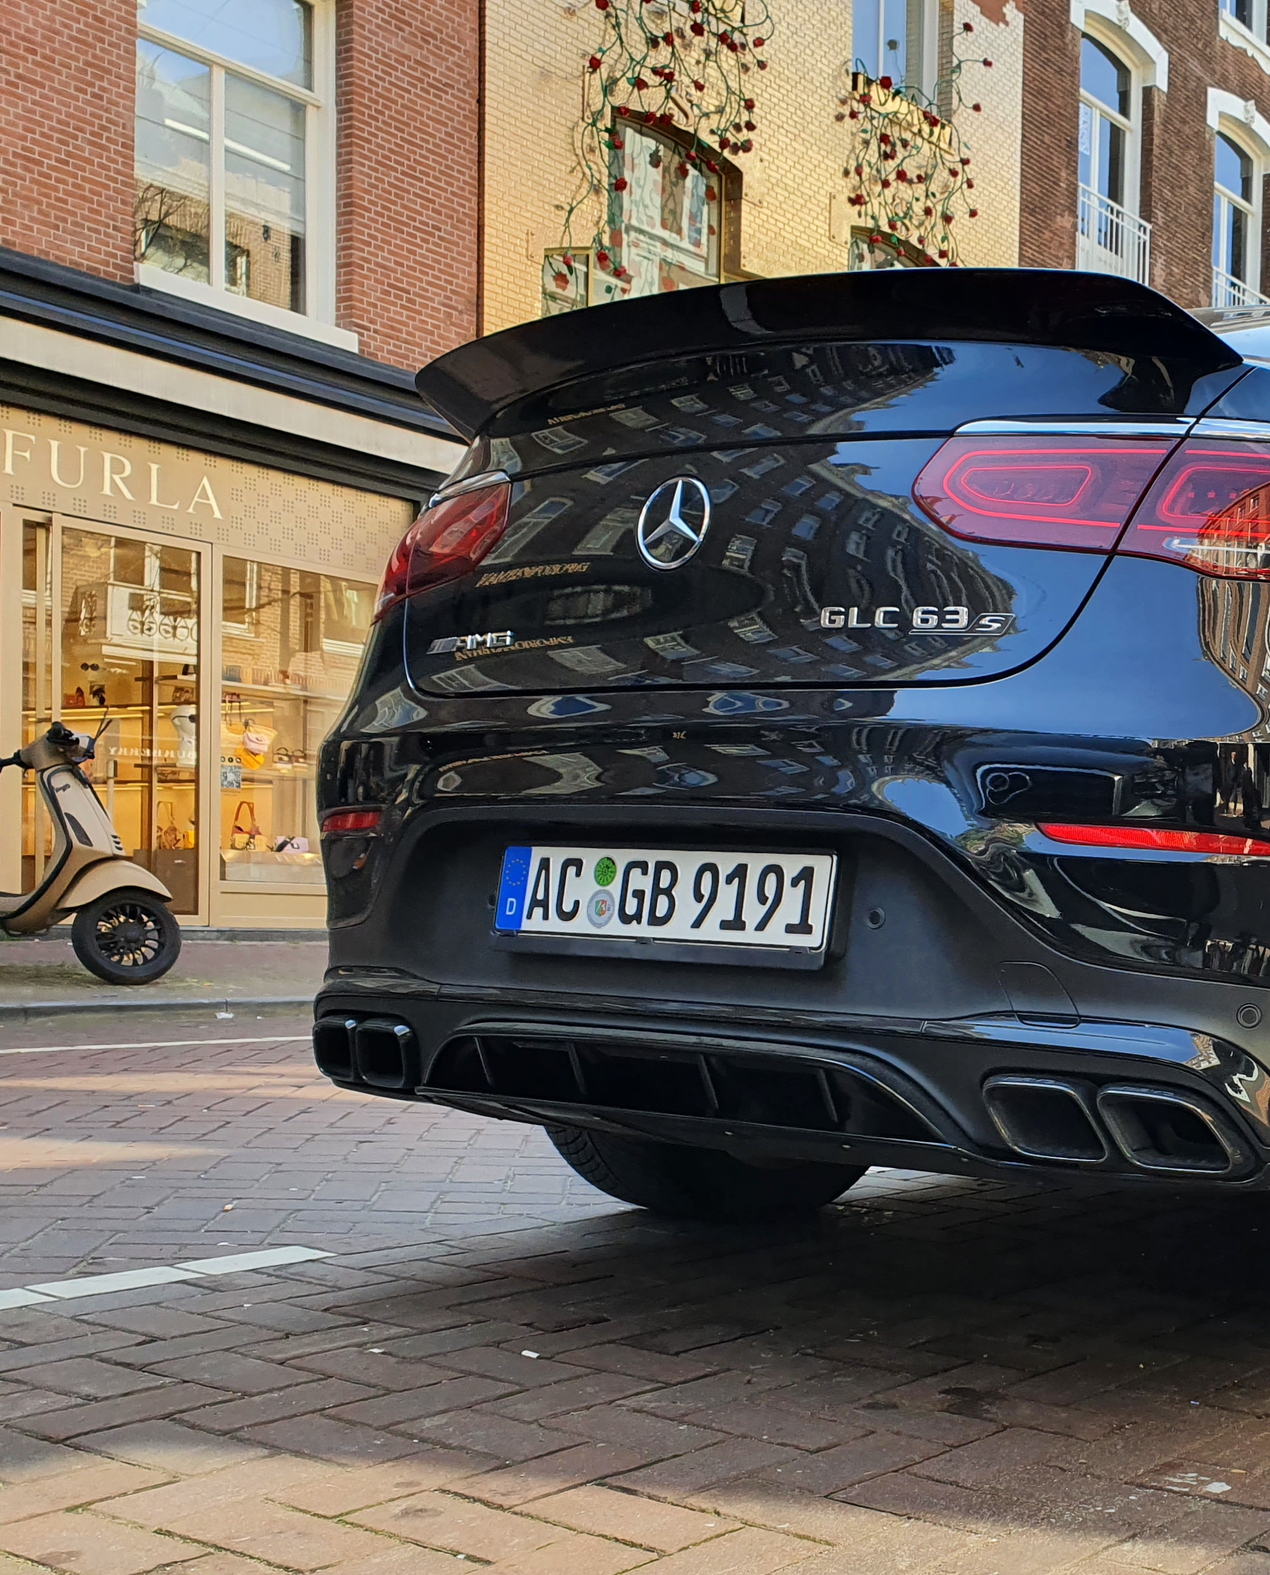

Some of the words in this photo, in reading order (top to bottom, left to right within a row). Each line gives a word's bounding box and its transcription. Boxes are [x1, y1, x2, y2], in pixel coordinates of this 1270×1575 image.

[2, 428, 224, 520] FURLA
[820, 606, 900, 629] GLC
[912, 606, 969, 629] 63
[457, 630, 515, 650] AMG
[505, 897, 517, 915] D
[526, 857, 584, 922] AC
[618, 860, 679, 927] GB
[690, 863, 816, 935] 9191
